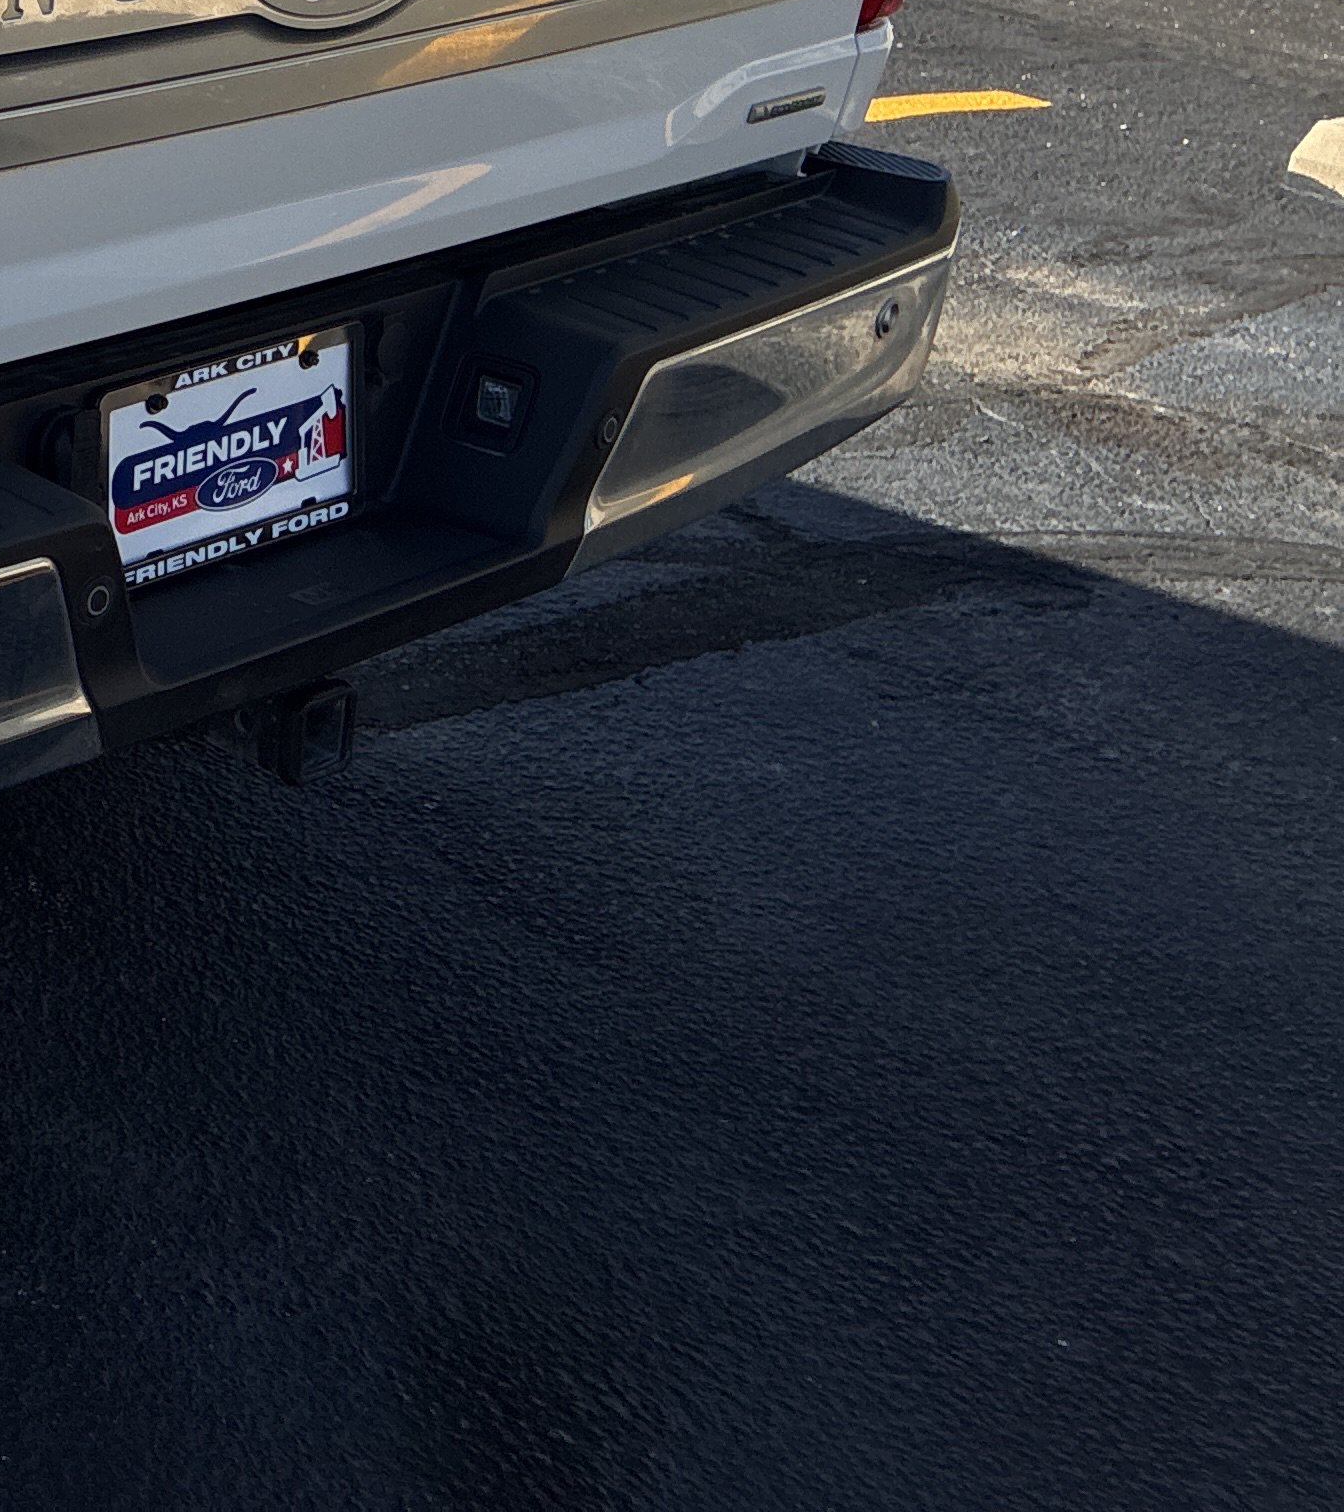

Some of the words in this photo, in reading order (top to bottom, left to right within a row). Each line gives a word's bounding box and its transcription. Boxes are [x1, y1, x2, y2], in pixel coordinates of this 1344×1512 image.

[174, 361, 229, 389] ARK
[236, 342, 294, 370] CITY
[132, 417, 288, 492] FRIENDLY
[212, 464, 262, 504] Ford
[126, 508, 146, 526] Ark
[172, 494, 188, 509] KS
[271, 501, 349, 538] FORD
